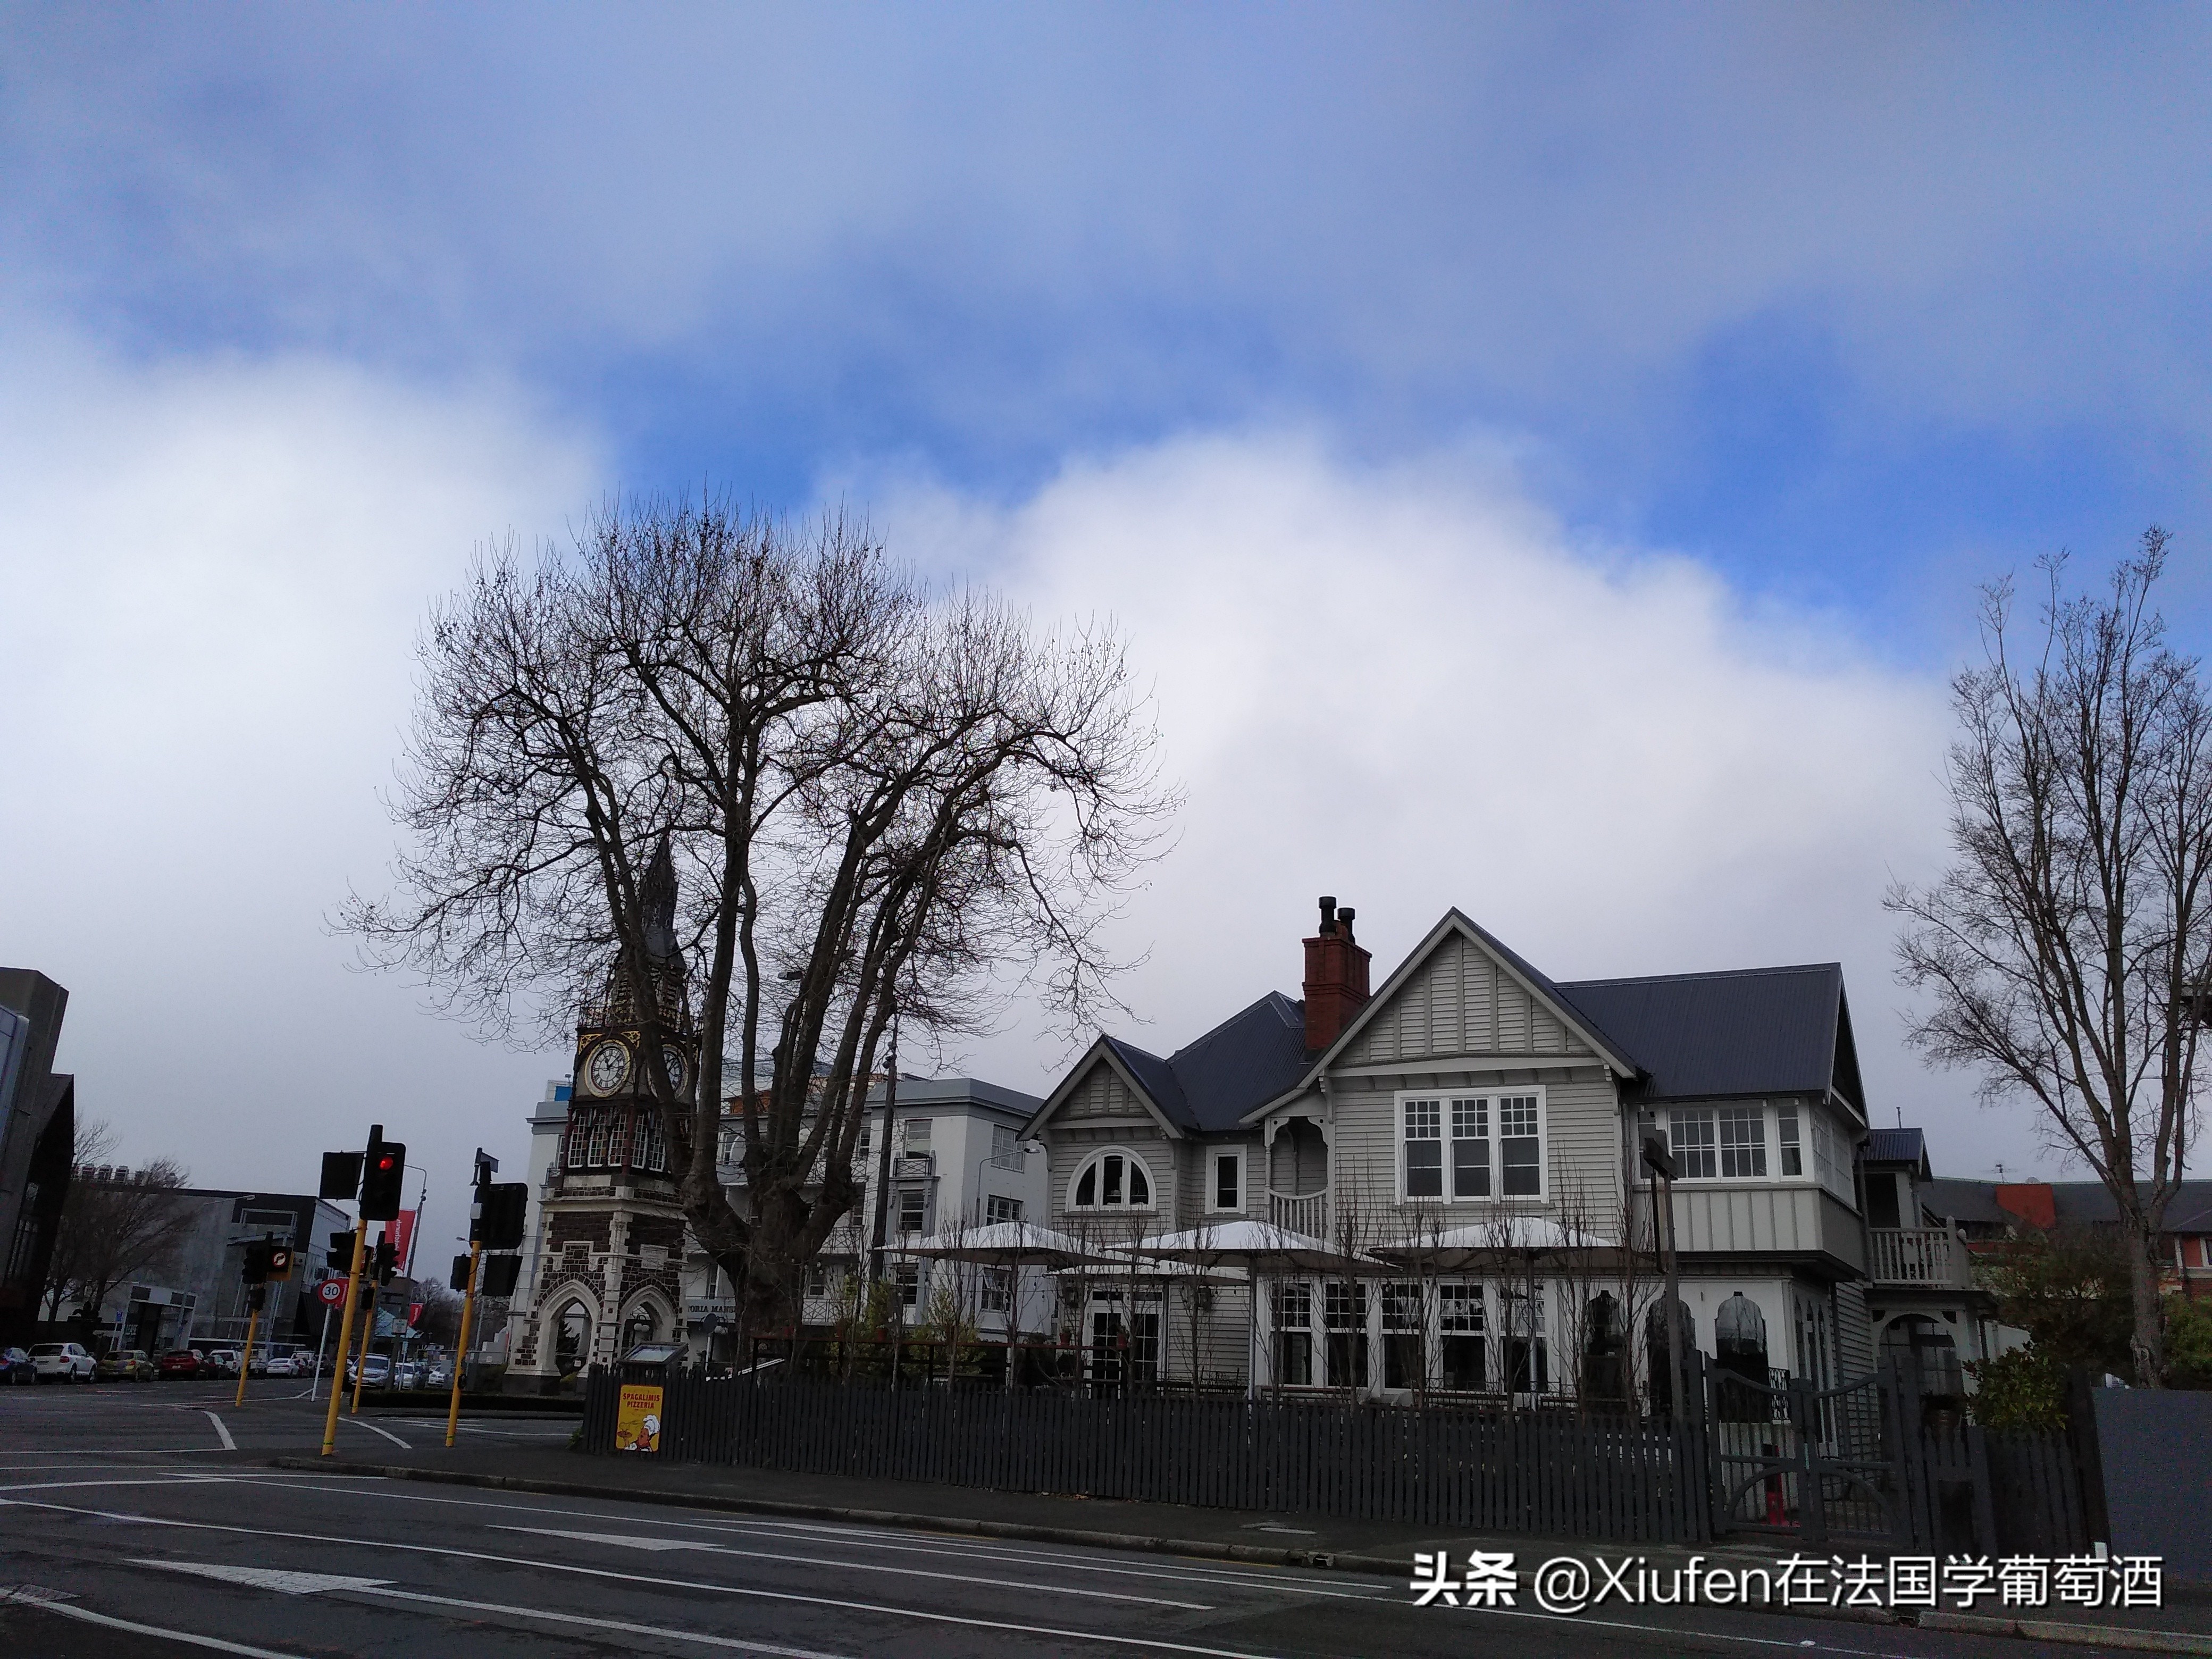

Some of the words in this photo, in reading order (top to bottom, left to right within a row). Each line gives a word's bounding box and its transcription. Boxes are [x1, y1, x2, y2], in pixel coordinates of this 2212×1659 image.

[324, 1287, 339, 1296] 30
[622, 1393, 660, 1402] SPAGALIMIS
[626, 1401, 655, 1409] PIZZERIA
